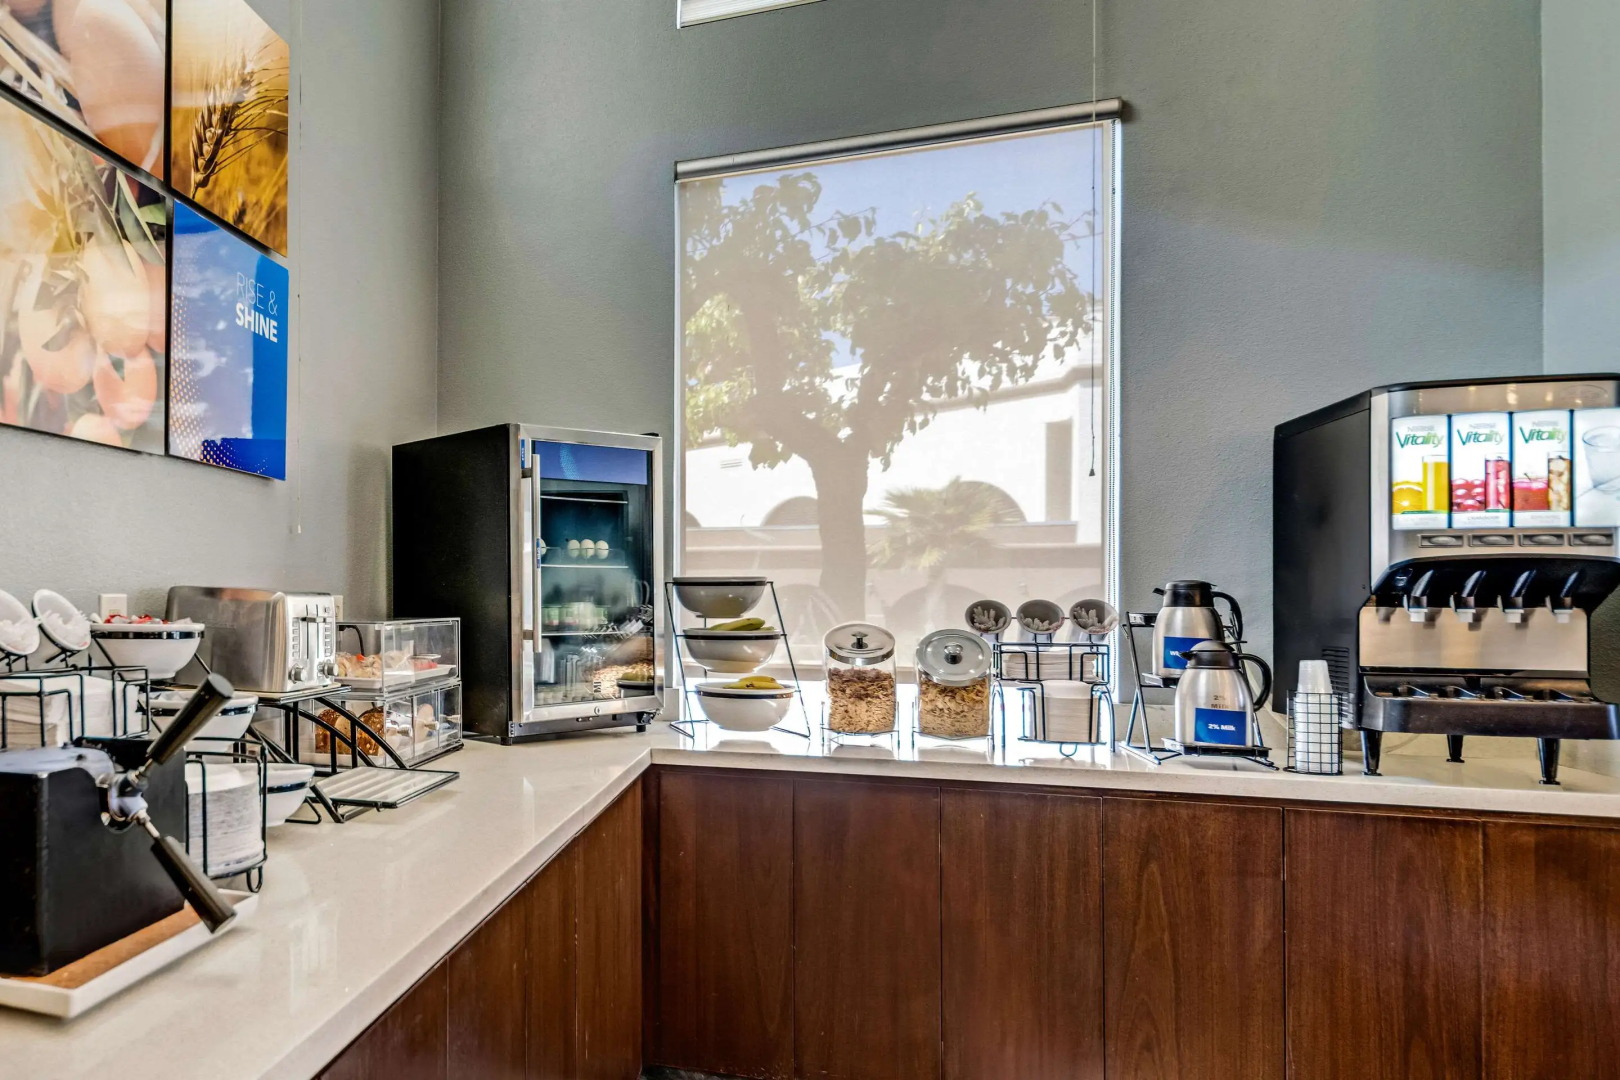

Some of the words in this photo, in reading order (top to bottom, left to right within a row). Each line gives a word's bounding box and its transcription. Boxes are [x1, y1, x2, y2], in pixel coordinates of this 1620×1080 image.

[236, 271, 264, 309] RISE
[268, 290, 278, 317] &
[235, 302, 278, 343] SHINE
[1396, 431, 1444, 448] Vitality
[1457, 429, 1504, 446] Vitality
[1519, 426, 1566, 444] Vitality
